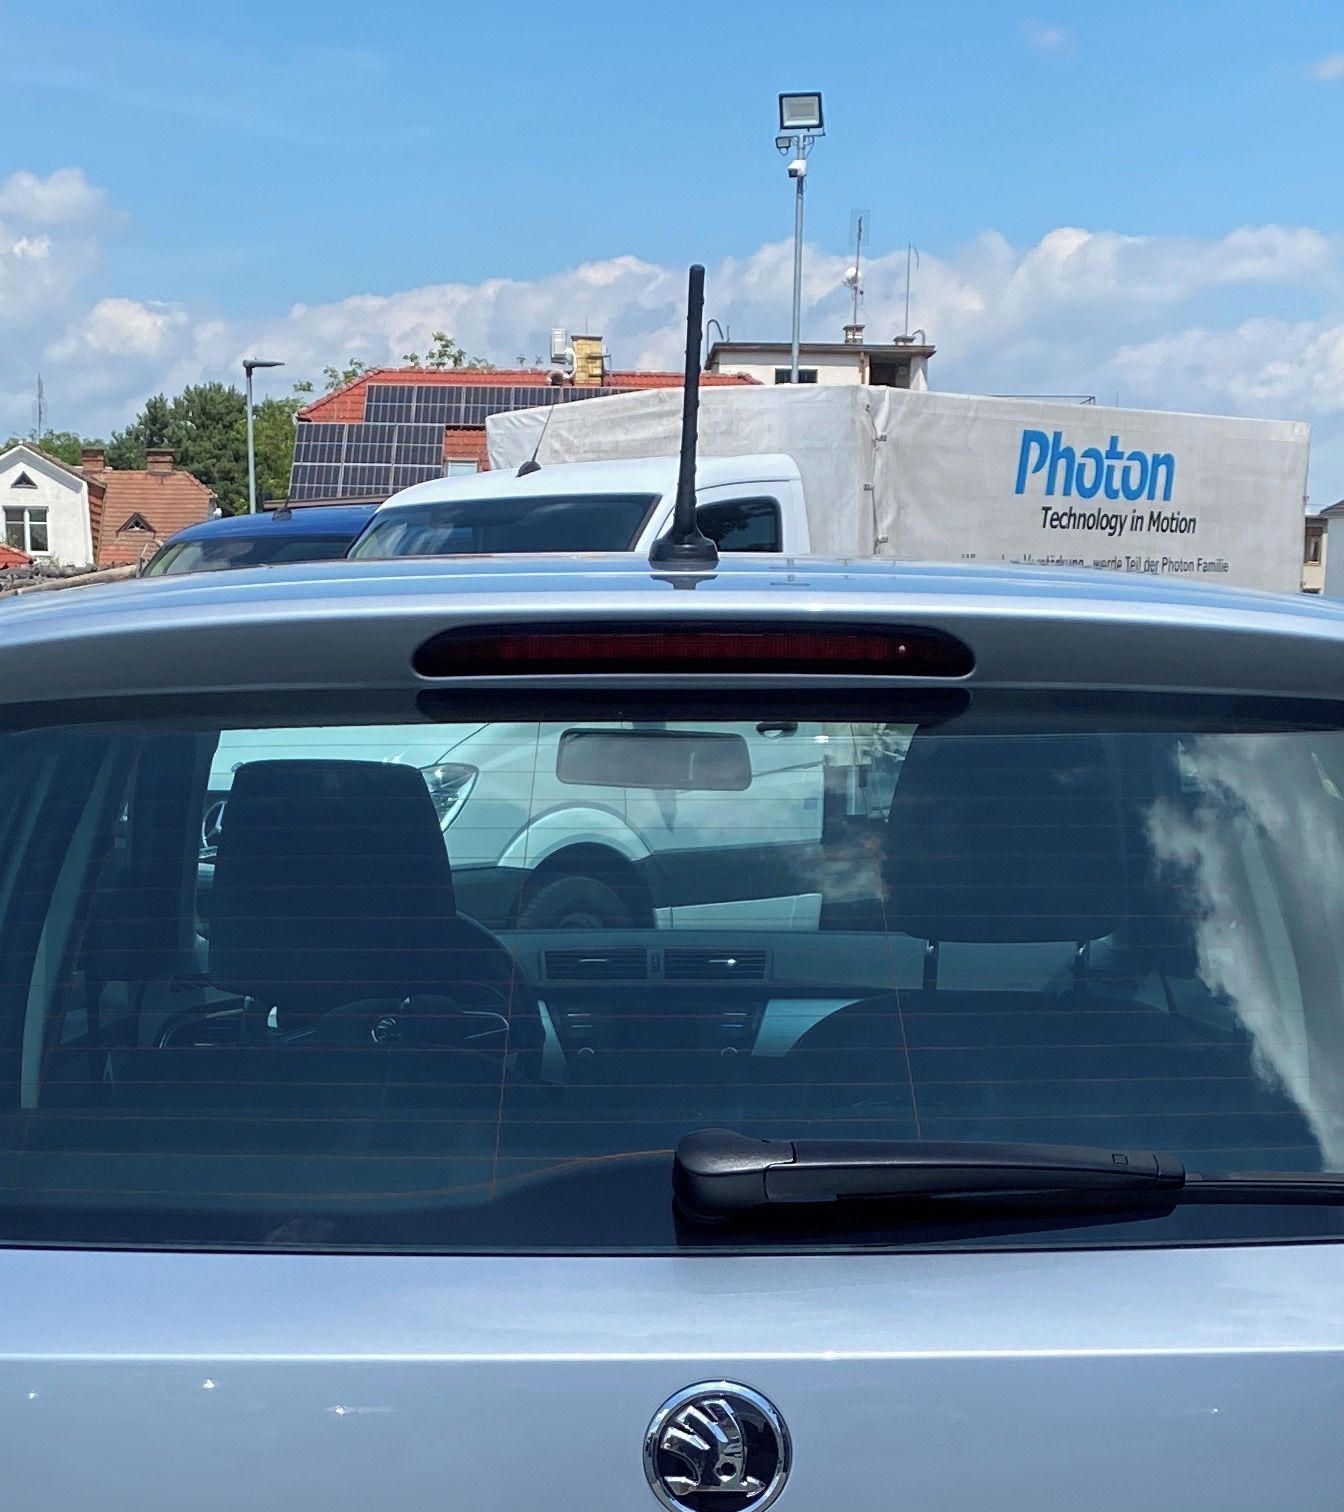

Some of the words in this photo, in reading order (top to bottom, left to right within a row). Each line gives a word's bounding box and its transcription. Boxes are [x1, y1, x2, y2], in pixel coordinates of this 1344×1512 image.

[1015, 429, 1176, 501] Photon
[1041, 506, 1128, 536] Technology
[1130, 509, 1146, 532] in
[1147, 510, 1197, 534] Motion
[1143, 556, 1160, 574] der
[1162, 557, 1194, 573] Photon
[1196, 558, 1229, 573] Familie
